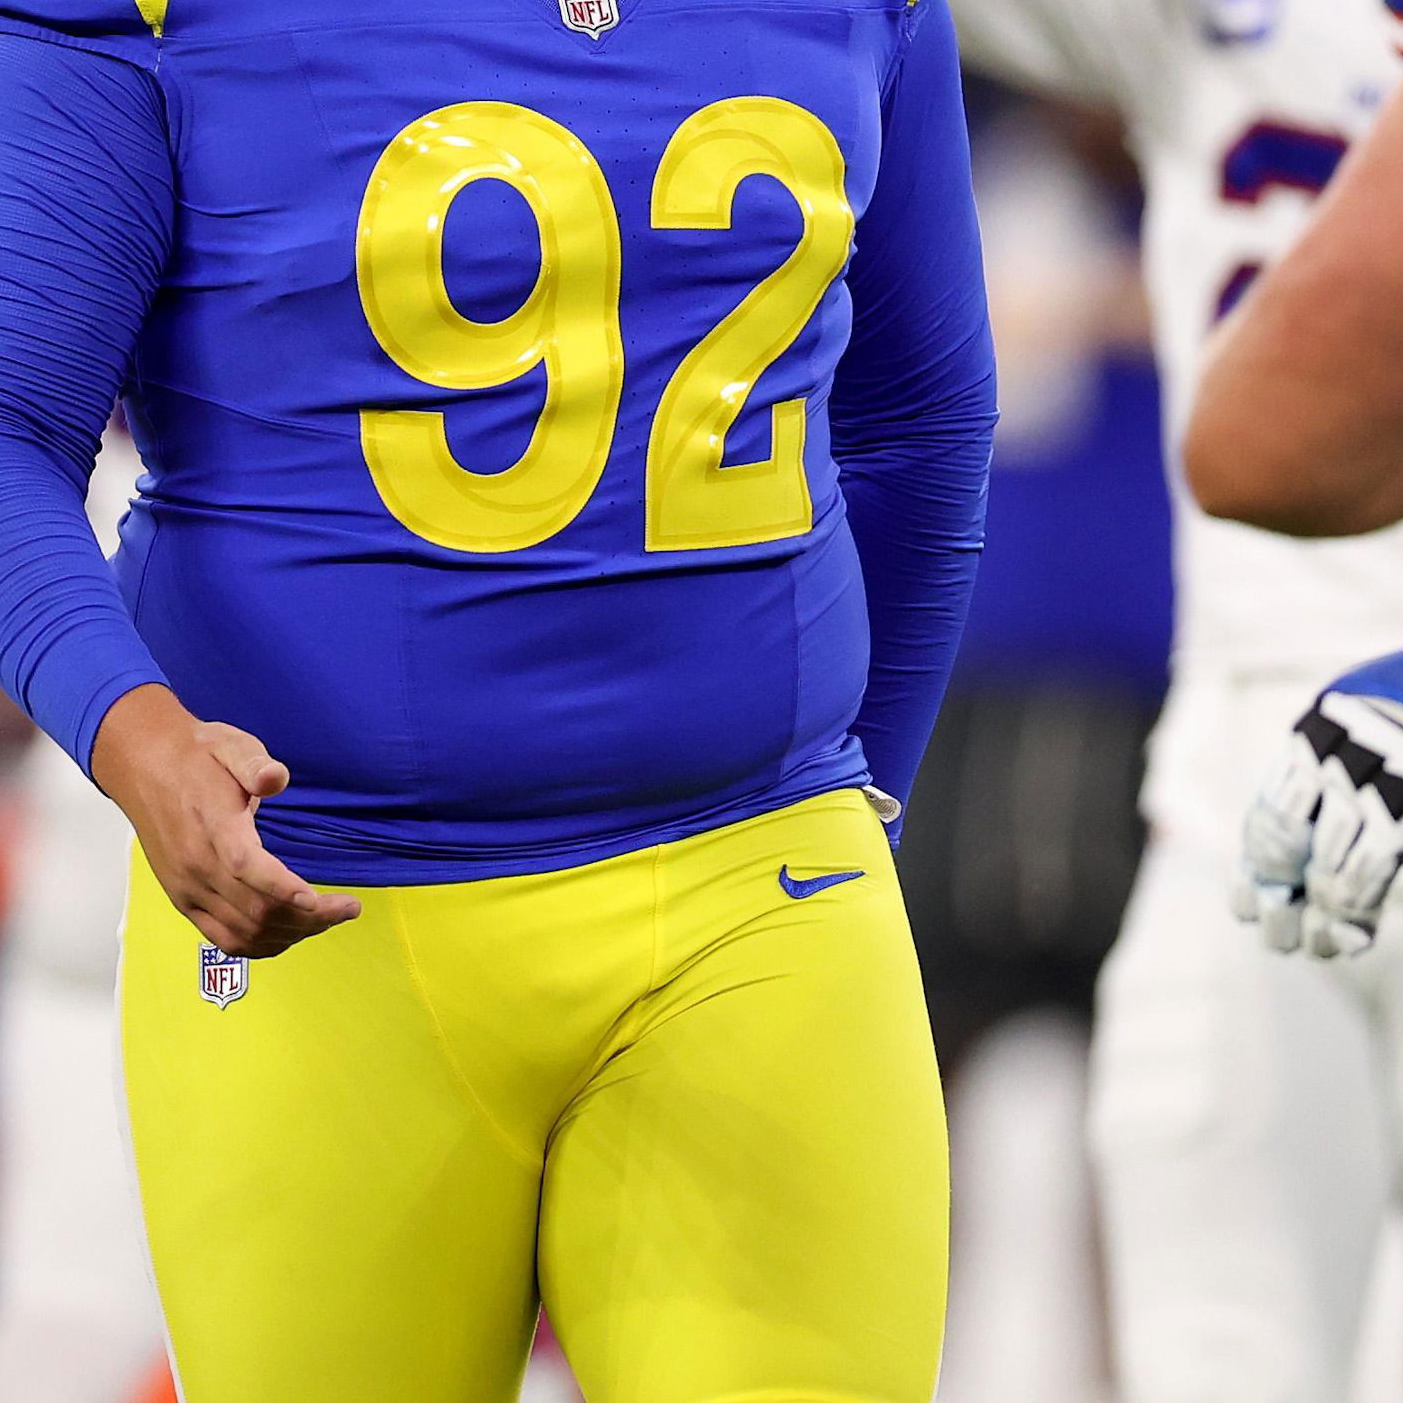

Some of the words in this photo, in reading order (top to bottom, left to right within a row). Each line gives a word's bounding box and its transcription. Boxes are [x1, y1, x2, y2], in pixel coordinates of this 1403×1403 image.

[569, 0, 610, 26] NFL
[355, 95, 855, 554] 92
[206, 967, 239, 995] NFL
